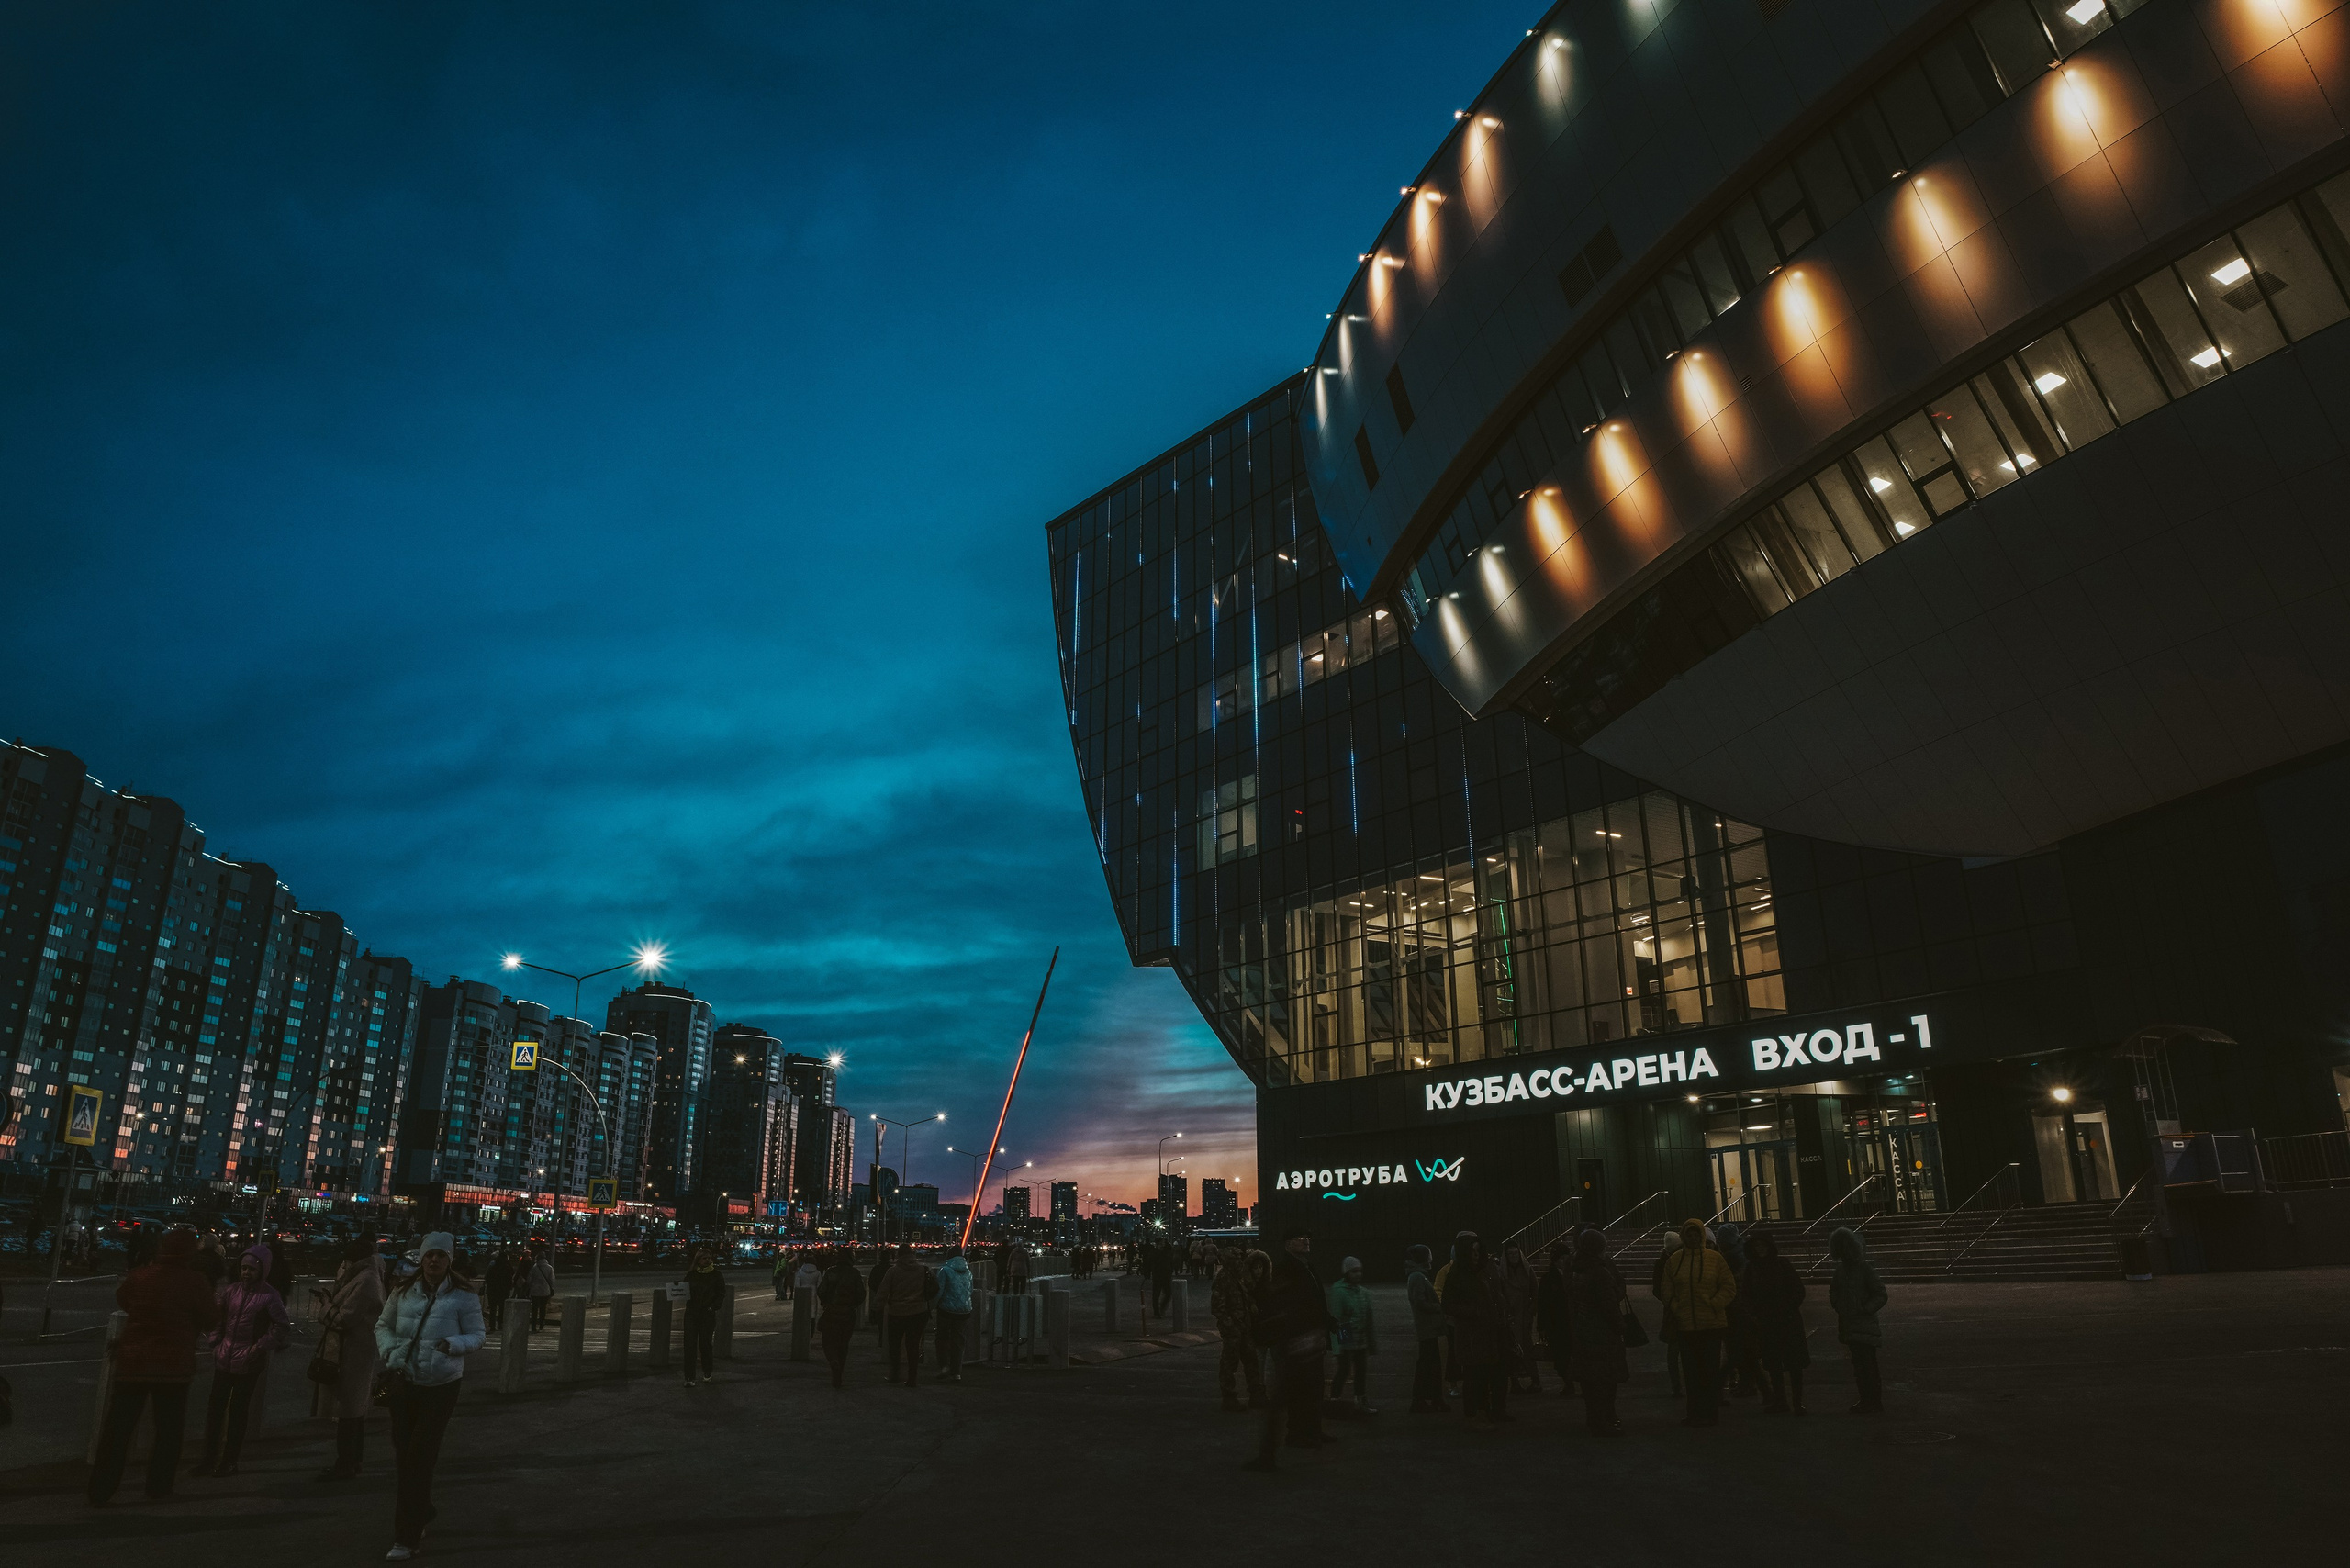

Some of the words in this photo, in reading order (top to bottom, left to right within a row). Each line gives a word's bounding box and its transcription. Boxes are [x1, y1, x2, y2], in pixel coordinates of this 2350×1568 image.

[1426, 1047, 1718, 1111] КУЗБАСС-АРЕНА
[1752, 1023, 1880, 1071] ВХОД
[1276, 1164, 1407, 1190] АЭРОТРУБА
[1800, 1155, 1822, 1163] КАССА
[1890, 1137, 1905, 1201] КАССА
